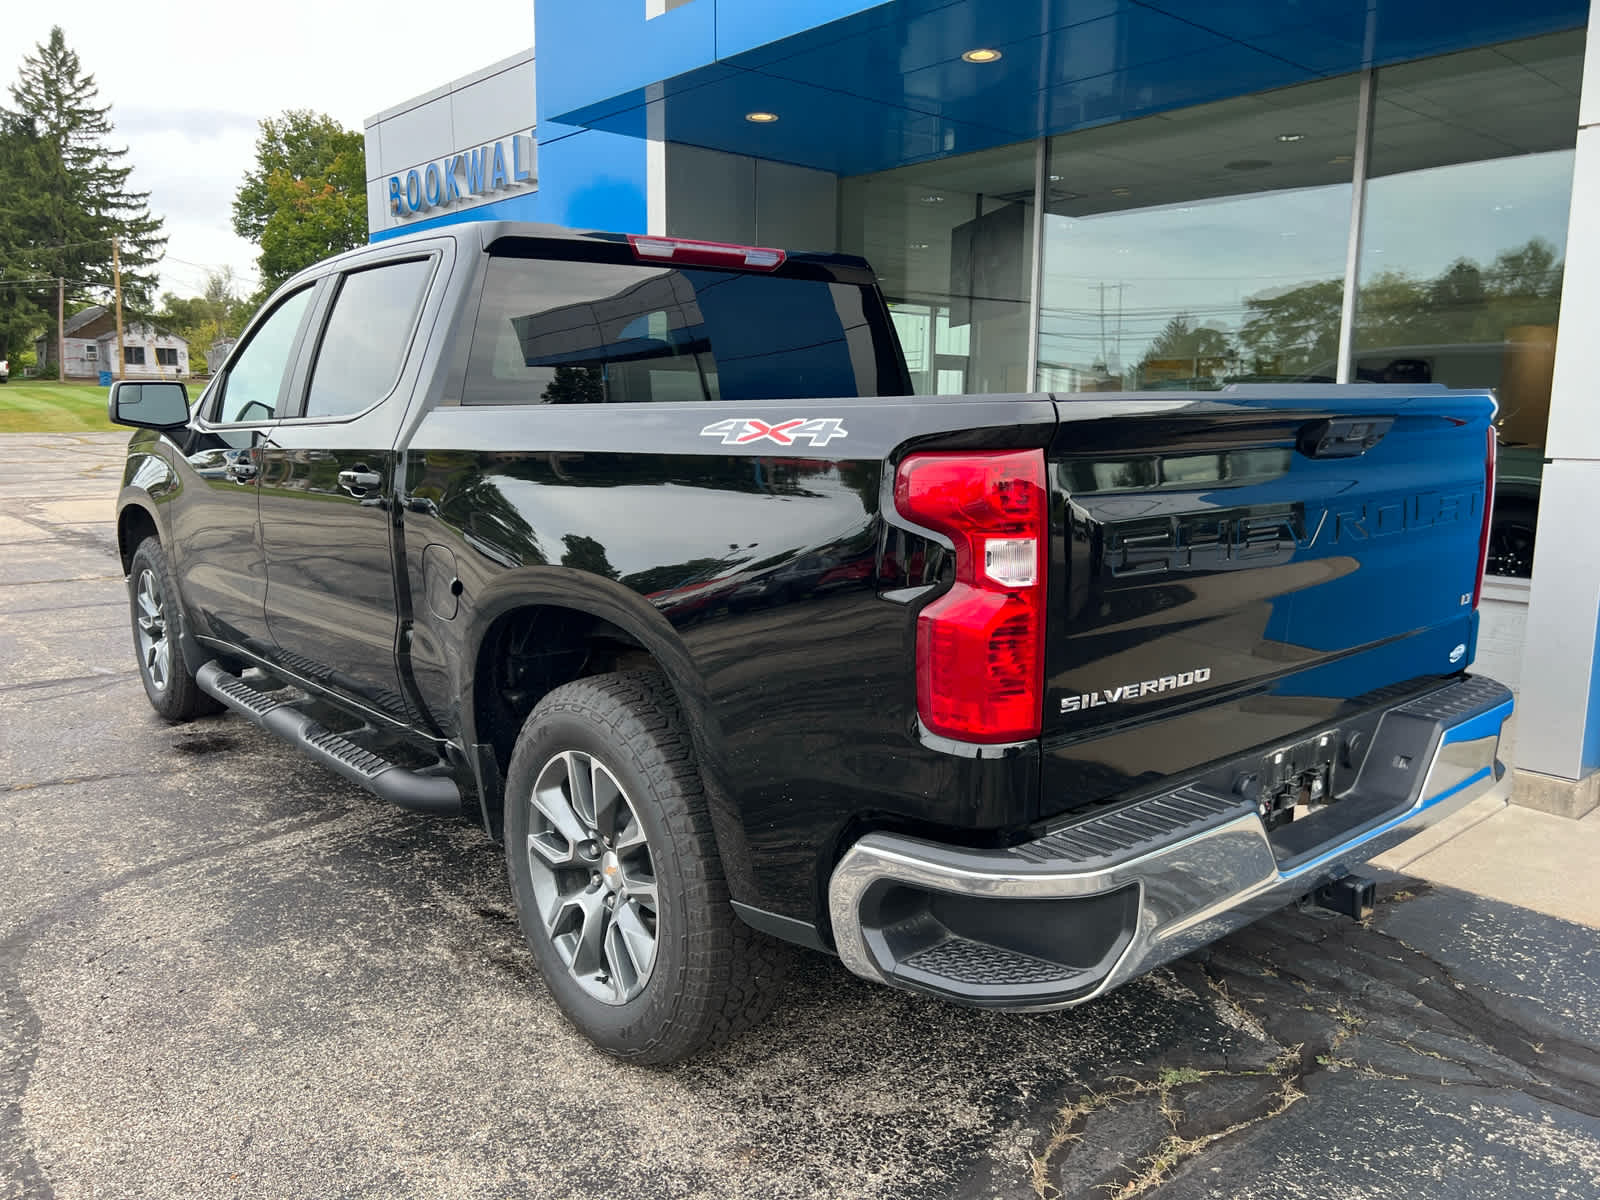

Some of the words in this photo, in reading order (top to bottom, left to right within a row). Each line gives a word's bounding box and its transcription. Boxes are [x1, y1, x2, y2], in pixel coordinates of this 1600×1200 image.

[389, 129, 537, 216] BOOKWAL
[1110, 491, 1480, 577] CHEVROLET
[1060, 668, 1211, 713] SILVERADO
